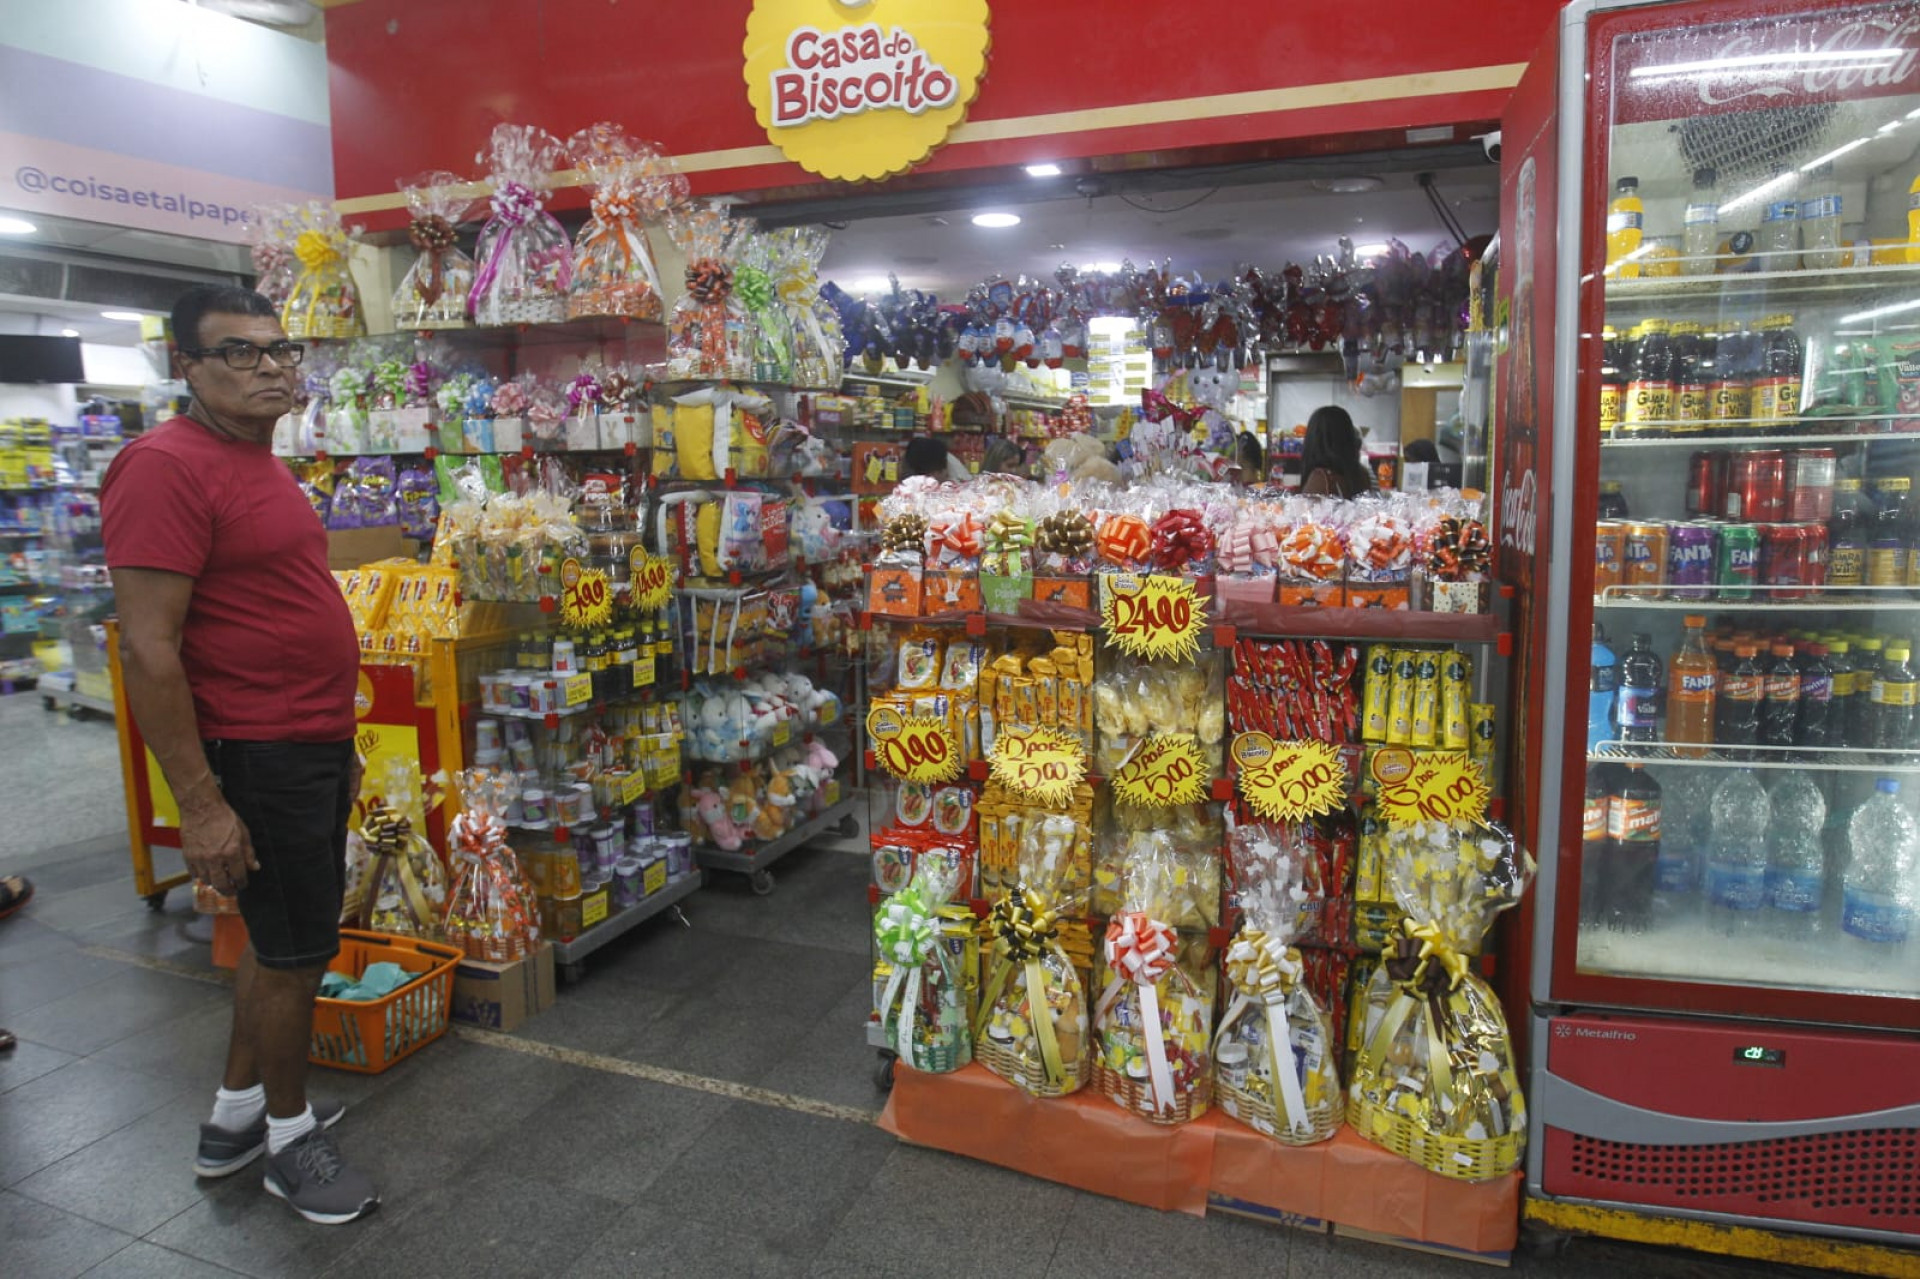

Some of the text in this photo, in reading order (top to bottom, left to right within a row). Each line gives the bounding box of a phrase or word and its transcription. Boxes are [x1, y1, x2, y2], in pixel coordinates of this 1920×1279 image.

[791, 29, 912, 70] Casa do
[776, 55, 952, 121] Biscoito
[15, 166, 262, 226] @coisaetalpape
[1246, 767, 1276, 789] 3
[1384, 783, 1421, 807] 3
[1576, 1027, 1637, 1041] Metalfrio
